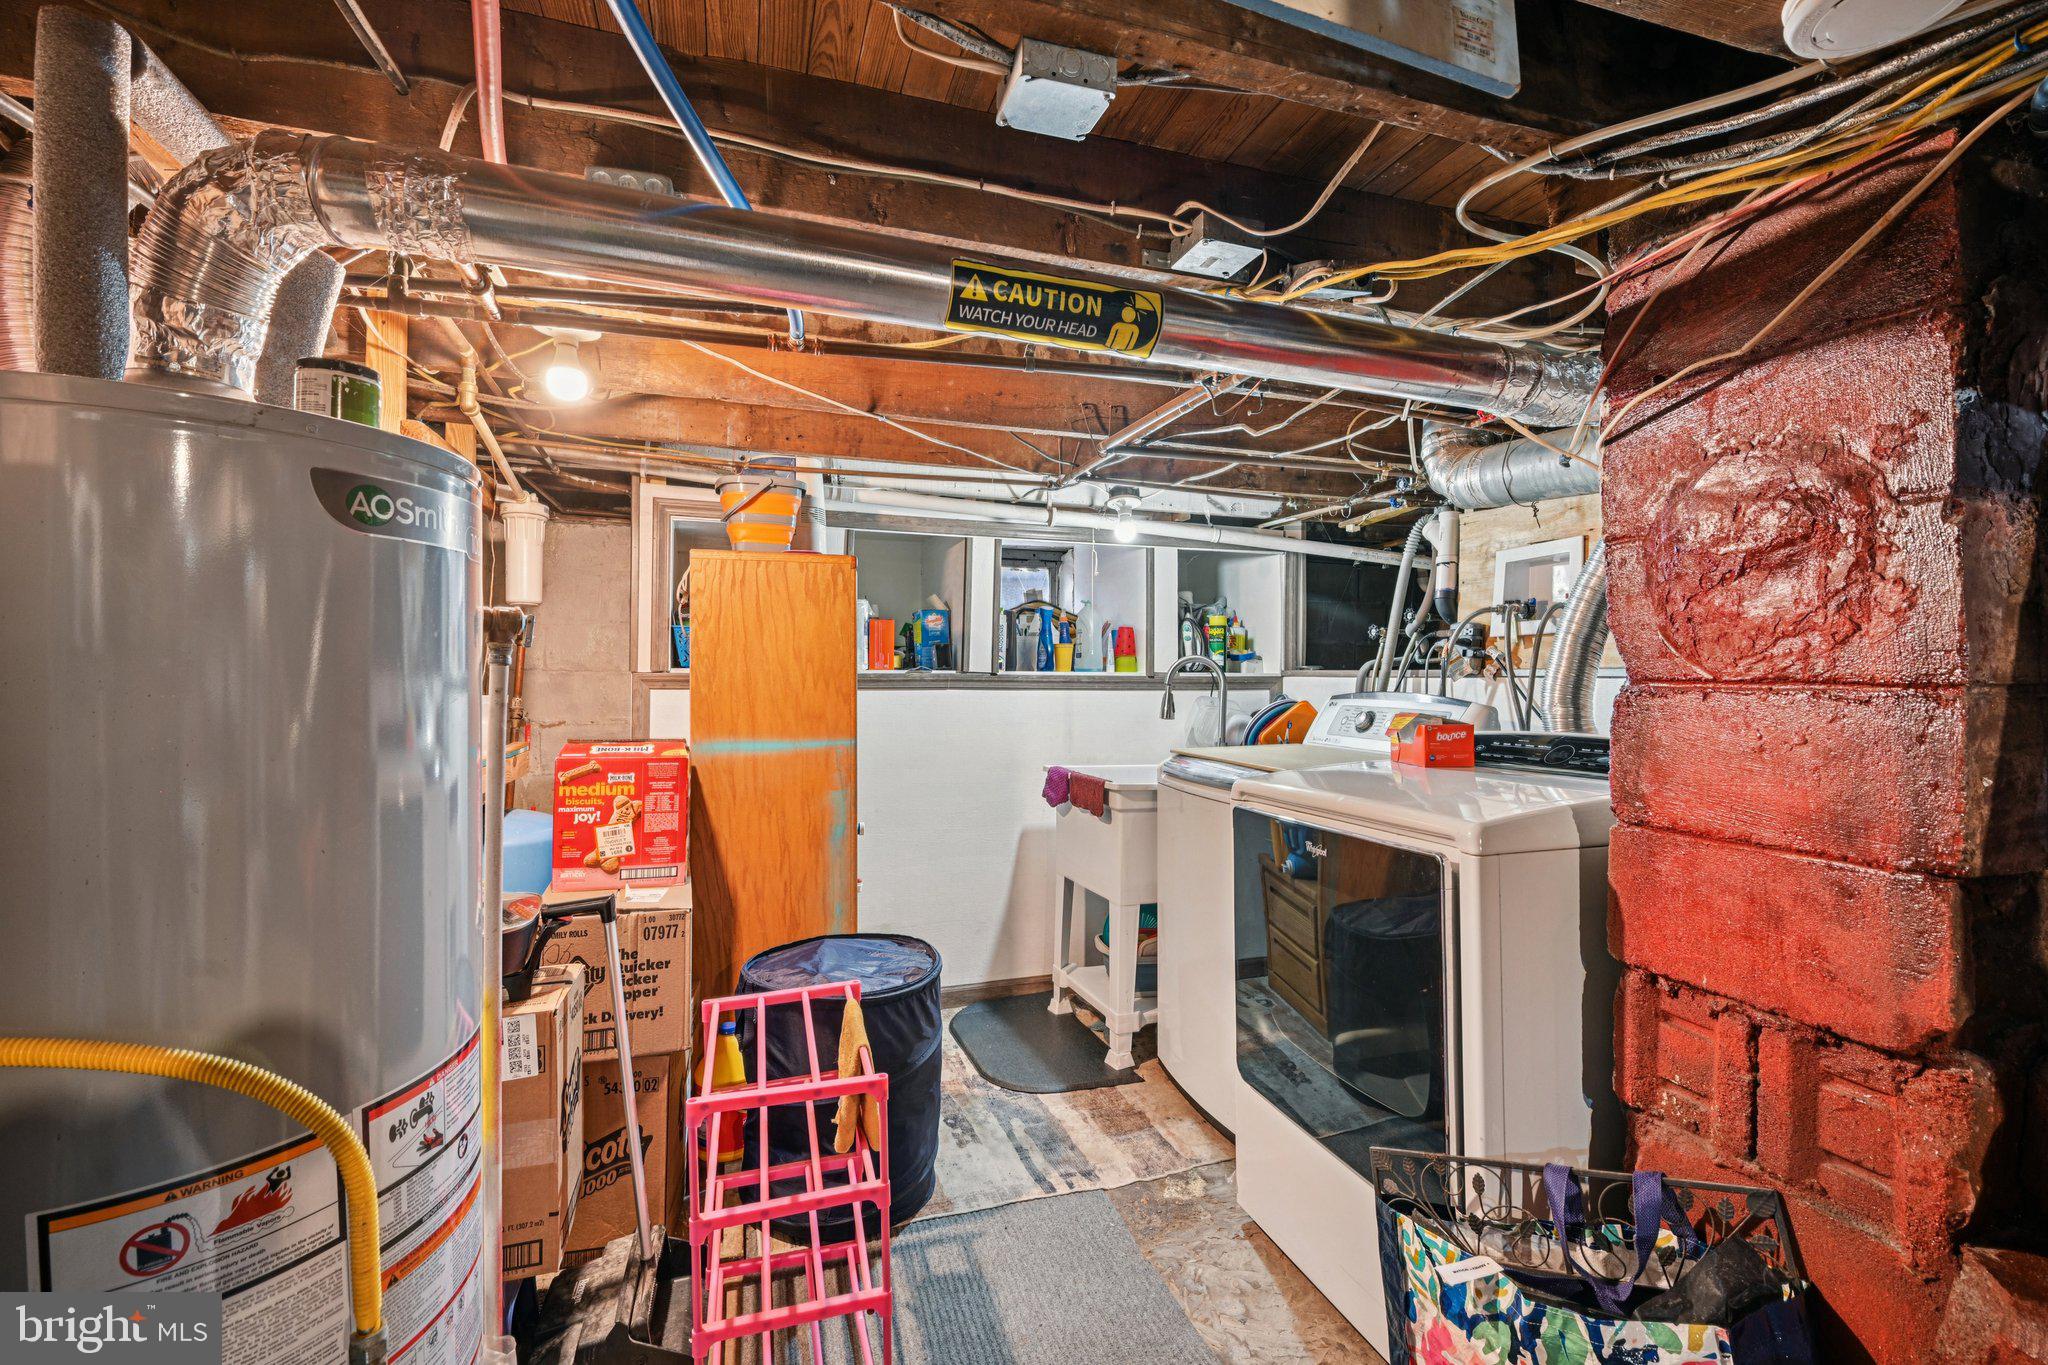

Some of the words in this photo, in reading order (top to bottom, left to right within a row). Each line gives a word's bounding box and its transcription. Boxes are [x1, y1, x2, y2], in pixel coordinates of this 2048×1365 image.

[993, 280, 1101, 317] CAUTION
[959, 304, 1012, 325] WATCH
[1015, 313, 1056, 332] YOUR
[1057, 321, 1097, 338] HEAD
[1437, 731, 1467, 741] bounce
[558, 782, 635, 796] medium
[565, 798, 604, 806] biscuits,
[573, 811, 601, 824] joy!
[1305, 841, 1328, 857] Whirlpool
[551, 931, 568, 939] MILY
[569, 930, 588, 938] ROLLS
[643, 924, 679, 941] 07977
[619, 948, 638, 960] he
[622, 973, 658, 986] icker
[624, 987, 659, 1002] pper
[601, 1006, 664, 1022] Divery!
[644, 1079, 658, 1091] 02
[179, 1169, 245, 1197] WARNING
[213, 1226, 254, 1246] Flammable
[256, 1215, 281, 1229] Vapors
[156, 1273, 172, 1284] FIRE
[174, 1268, 190, 1279] AND
[191, 1254, 231, 1273] EXPLOSION
[231, 1242, 259, 1259] HAZARD
[220, 1260, 239, 1274] injury
[248, 1249, 266, 1259] death
[257, 1256, 269, 1266] and
